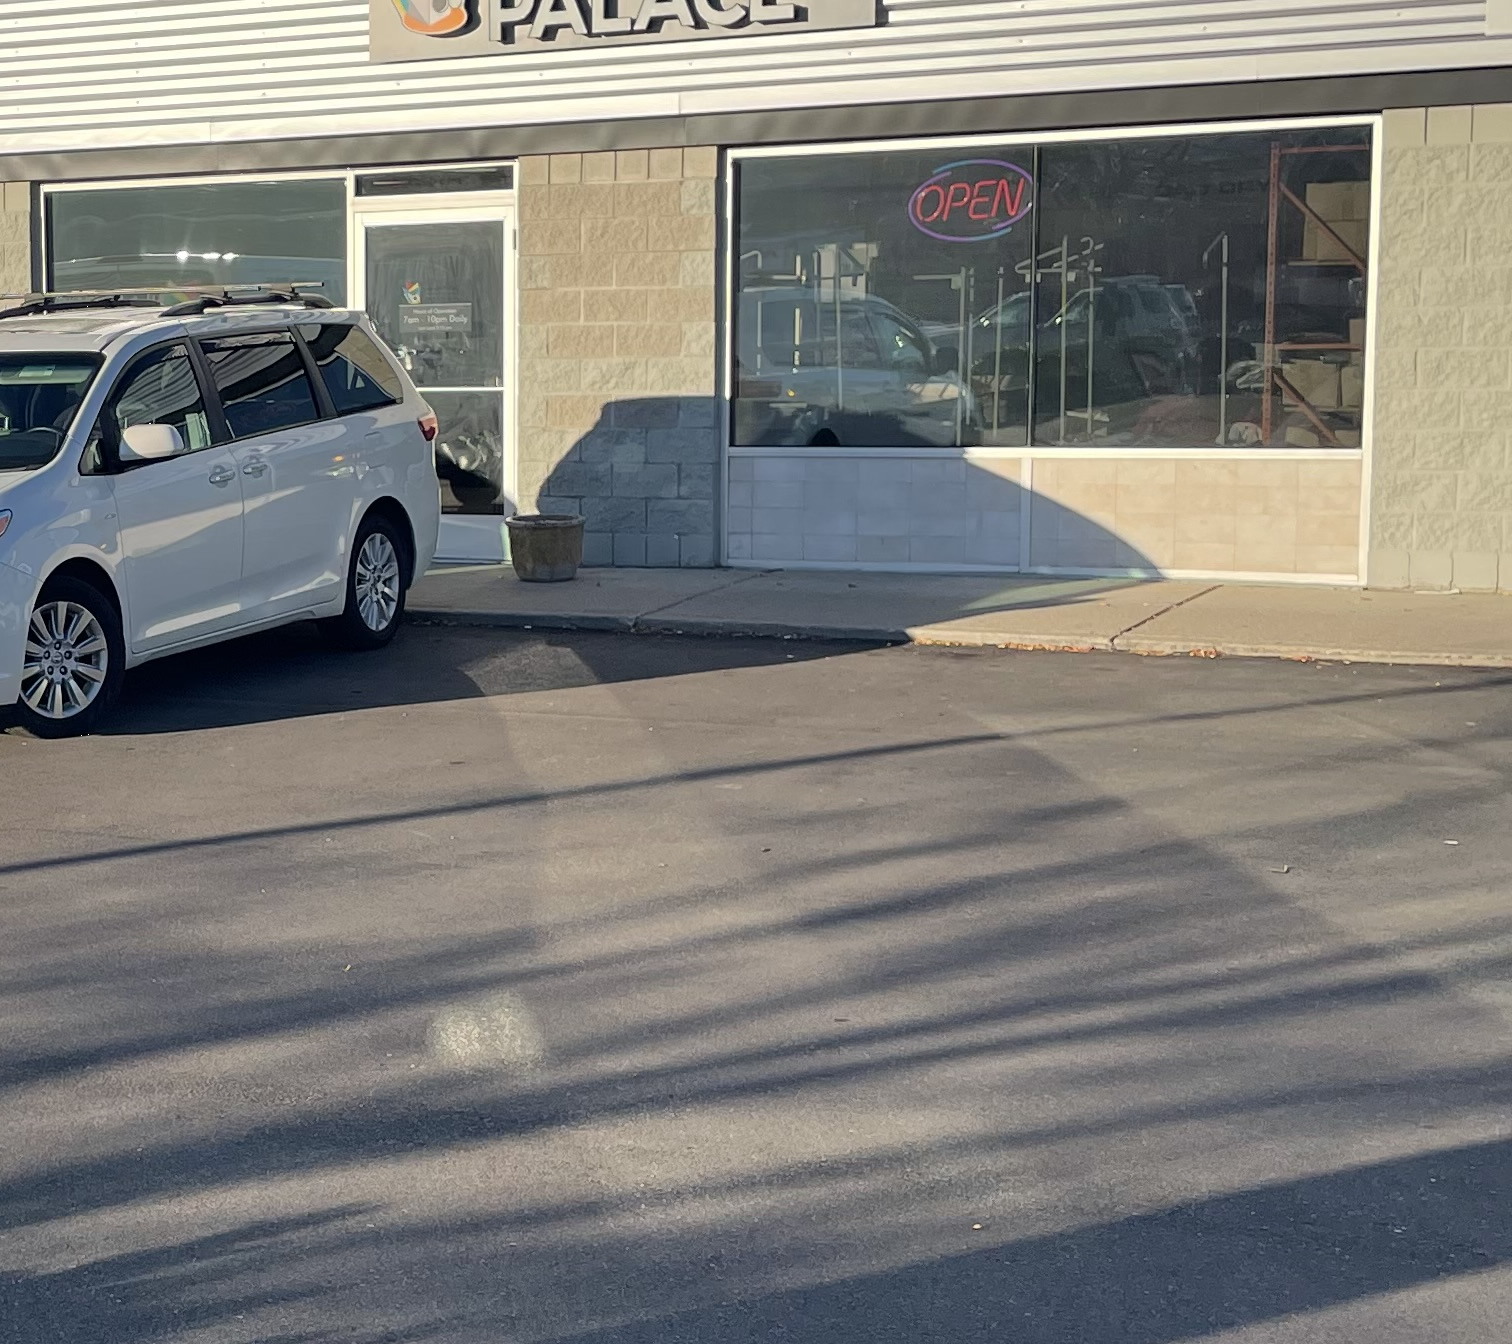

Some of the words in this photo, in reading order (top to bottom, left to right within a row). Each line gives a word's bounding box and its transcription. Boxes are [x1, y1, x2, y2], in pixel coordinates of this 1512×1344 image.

[916, 177, 1025, 222] OPEN
[403, 315, 420, 324] 7am
[427, 314, 448, 324] 10pm
